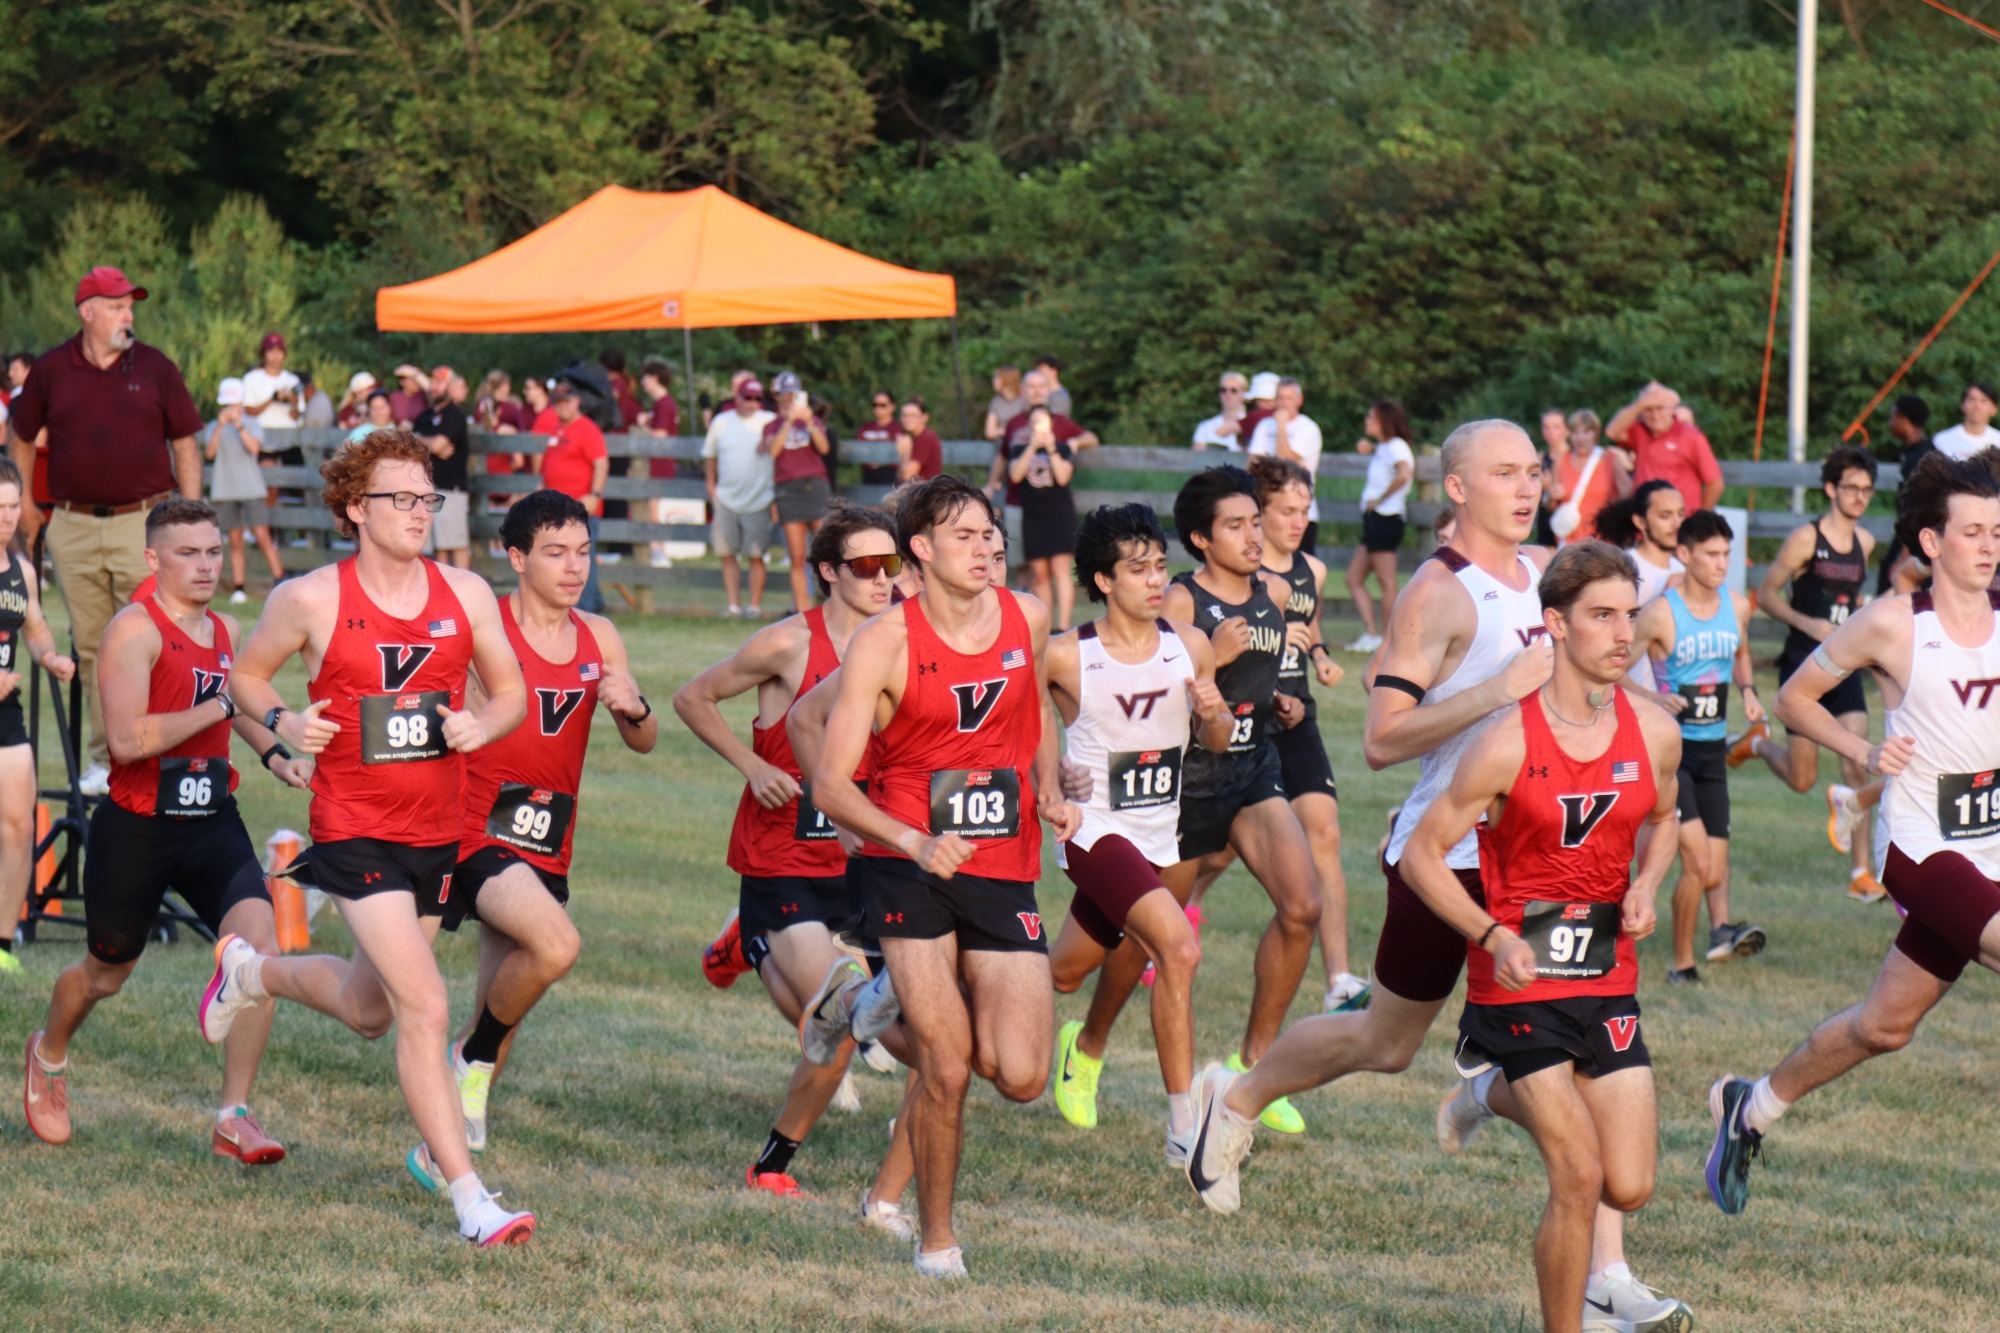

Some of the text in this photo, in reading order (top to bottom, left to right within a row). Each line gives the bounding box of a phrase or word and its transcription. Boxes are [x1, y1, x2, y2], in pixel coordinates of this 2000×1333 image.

[0, 590, 27, 617] RUM
[375, 644, 436, 693] V
[190, 667, 225, 708] V
[393, 694, 422, 710] SNAP
[1113, 687, 1171, 721] VT
[1948, 678, 2000, 712] VT
[535, 687, 586, 736] V
[950, 677, 1009, 733] V
[1694, 695, 1719, 718] 78
[387, 714, 429, 749] 98
[373, 750, 440, 760] www.snaptiming.com
[179, 777, 212, 806] 96
[965, 771, 993, 787] SNAP
[1122, 766, 1173, 797] 118
[511, 805, 552, 841] 99
[948, 790, 1006, 826] 103
[1557, 790, 1621, 848] V
[1954, 787, 2000, 826] 119
[1016, 911, 1042, 940] V
[1560, 903, 1592, 920] SNAP
[1549, 926, 1594, 963] 97
[1603, 1015, 1638, 1053] V
